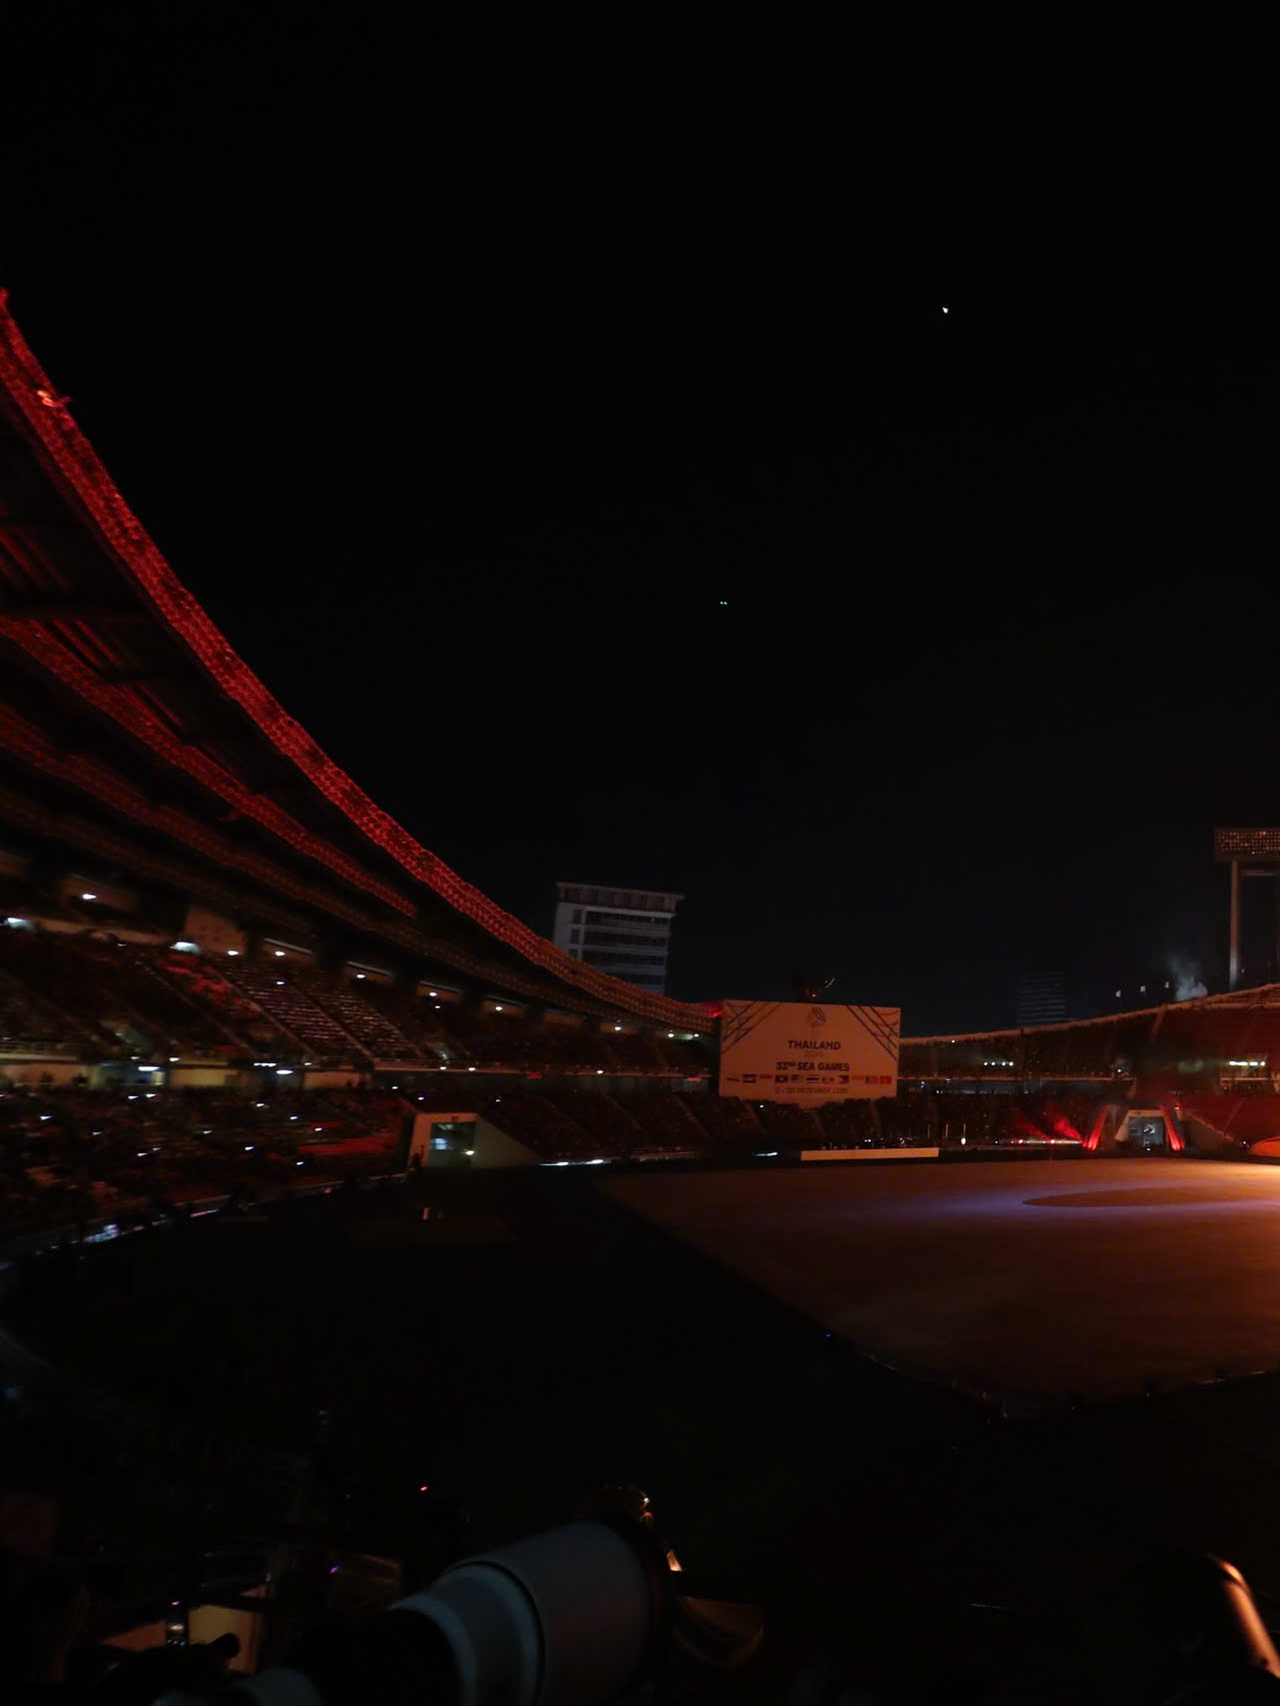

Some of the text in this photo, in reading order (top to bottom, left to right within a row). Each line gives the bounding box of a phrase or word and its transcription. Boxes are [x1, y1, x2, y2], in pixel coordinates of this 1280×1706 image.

[787, 1040, 841, 1050] THAILAND
[797, 1062, 815, 1071] SEA
[818, 1062, 850, 1071] GAMES
